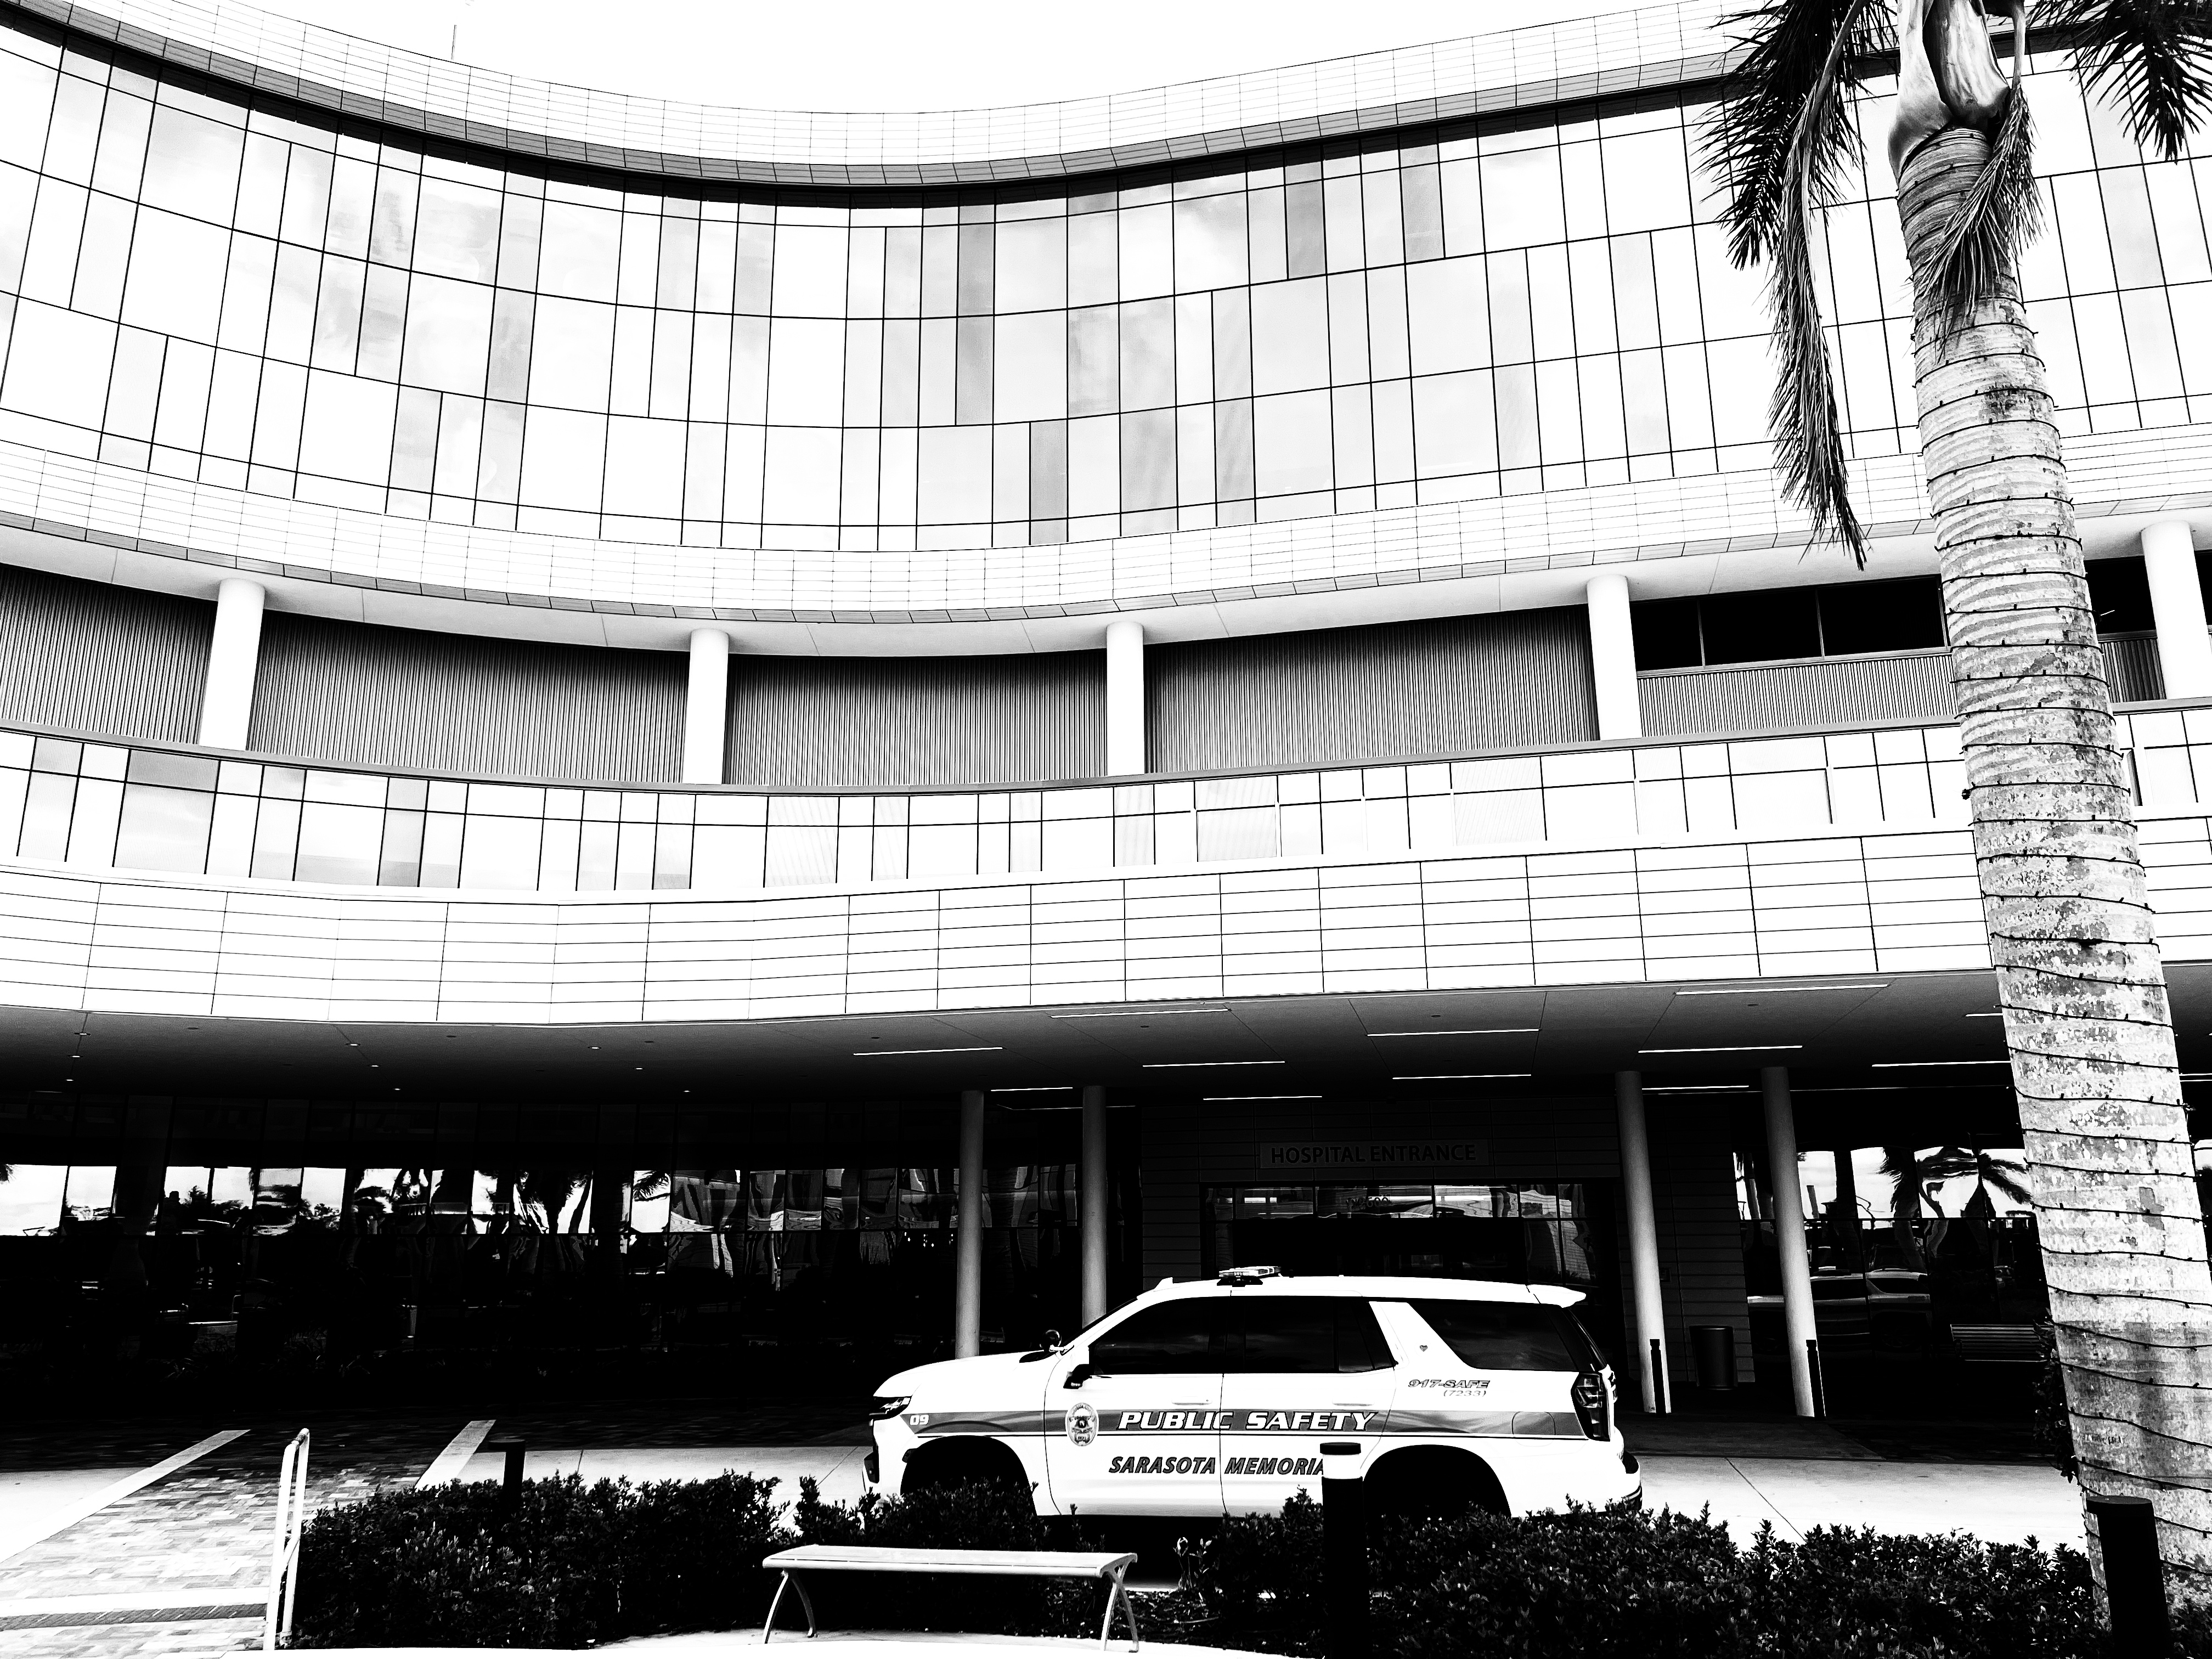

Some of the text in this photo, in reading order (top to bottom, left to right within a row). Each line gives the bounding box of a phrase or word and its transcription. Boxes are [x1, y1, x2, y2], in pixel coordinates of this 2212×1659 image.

[1271, 1143, 1476, 1164] HOSPITAL ENTRANCE
[1408, 1379, 1491, 1389] 917-SAFE
[910, 1414, 929, 1426] 09
[1116, 1410, 1379, 1431] PUBLIC SAFETY
[1108, 1455, 1324, 1476] SARASOTA MEMORIA
